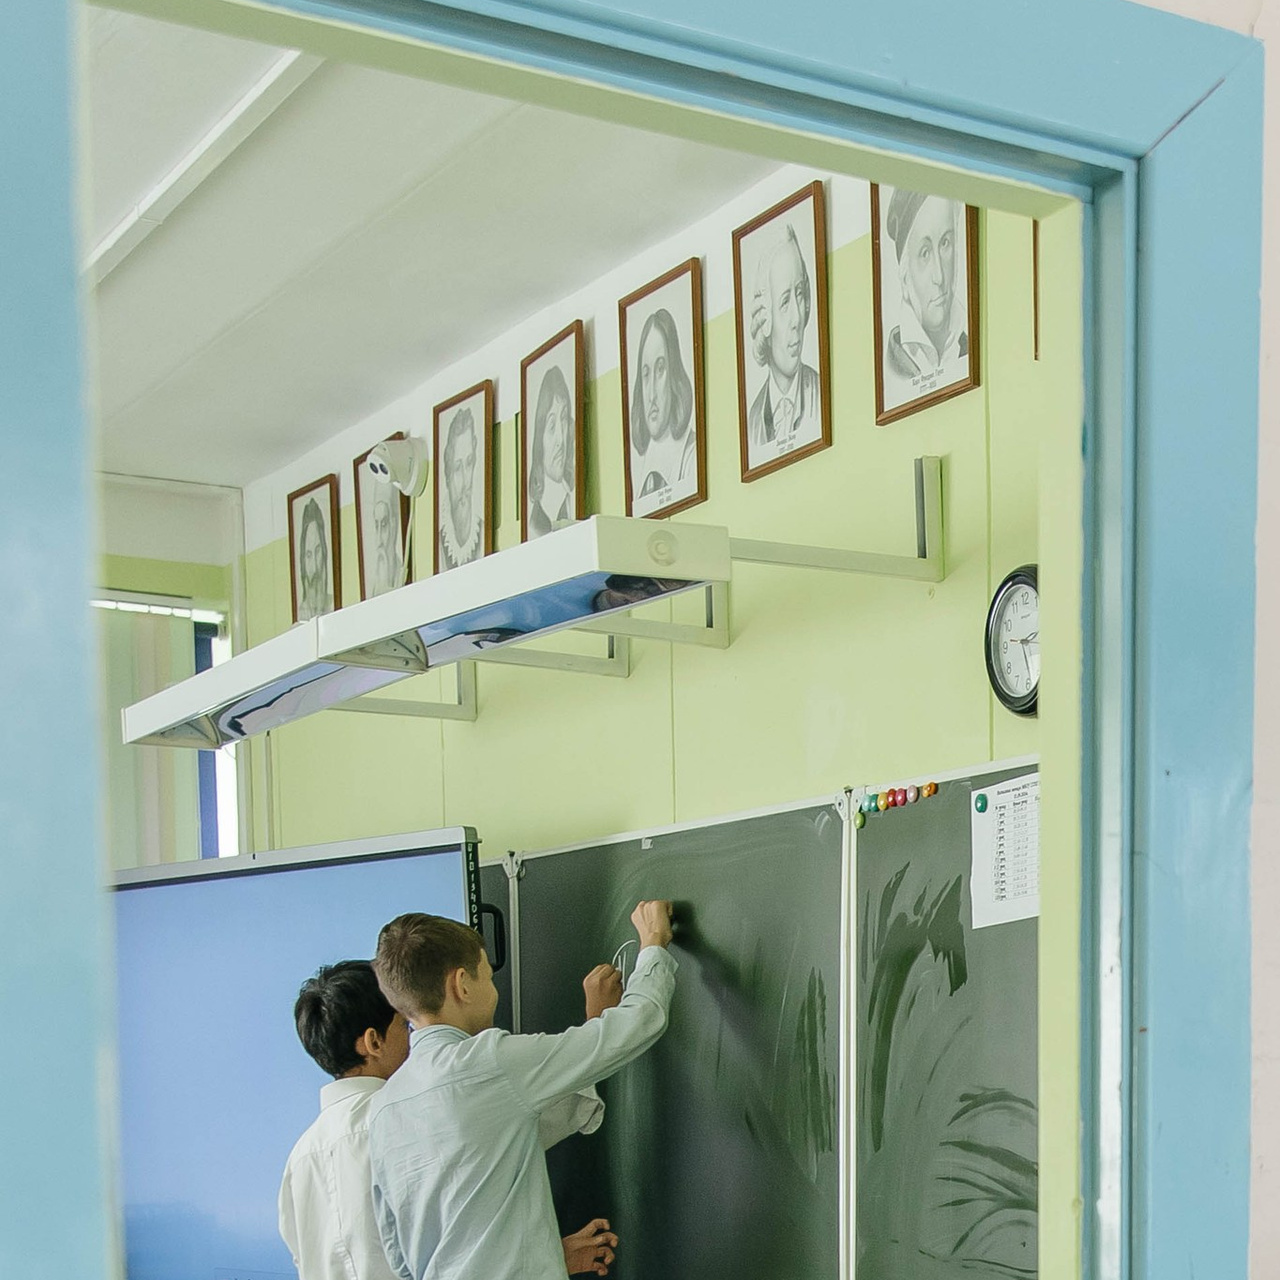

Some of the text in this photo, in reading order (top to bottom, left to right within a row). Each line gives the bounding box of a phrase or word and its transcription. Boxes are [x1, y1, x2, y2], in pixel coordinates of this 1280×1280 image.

[1021, 591, 1029, 605] 12
[1011, 602, 1018, 614] 11
[1004, 619, 1012, 632] 10
[1003, 641, 1008, 654] 9
[1006, 661, 1011, 675] 8
[1014, 675, 1020, 687] 7
[1025, 678, 1031, 691] 6
